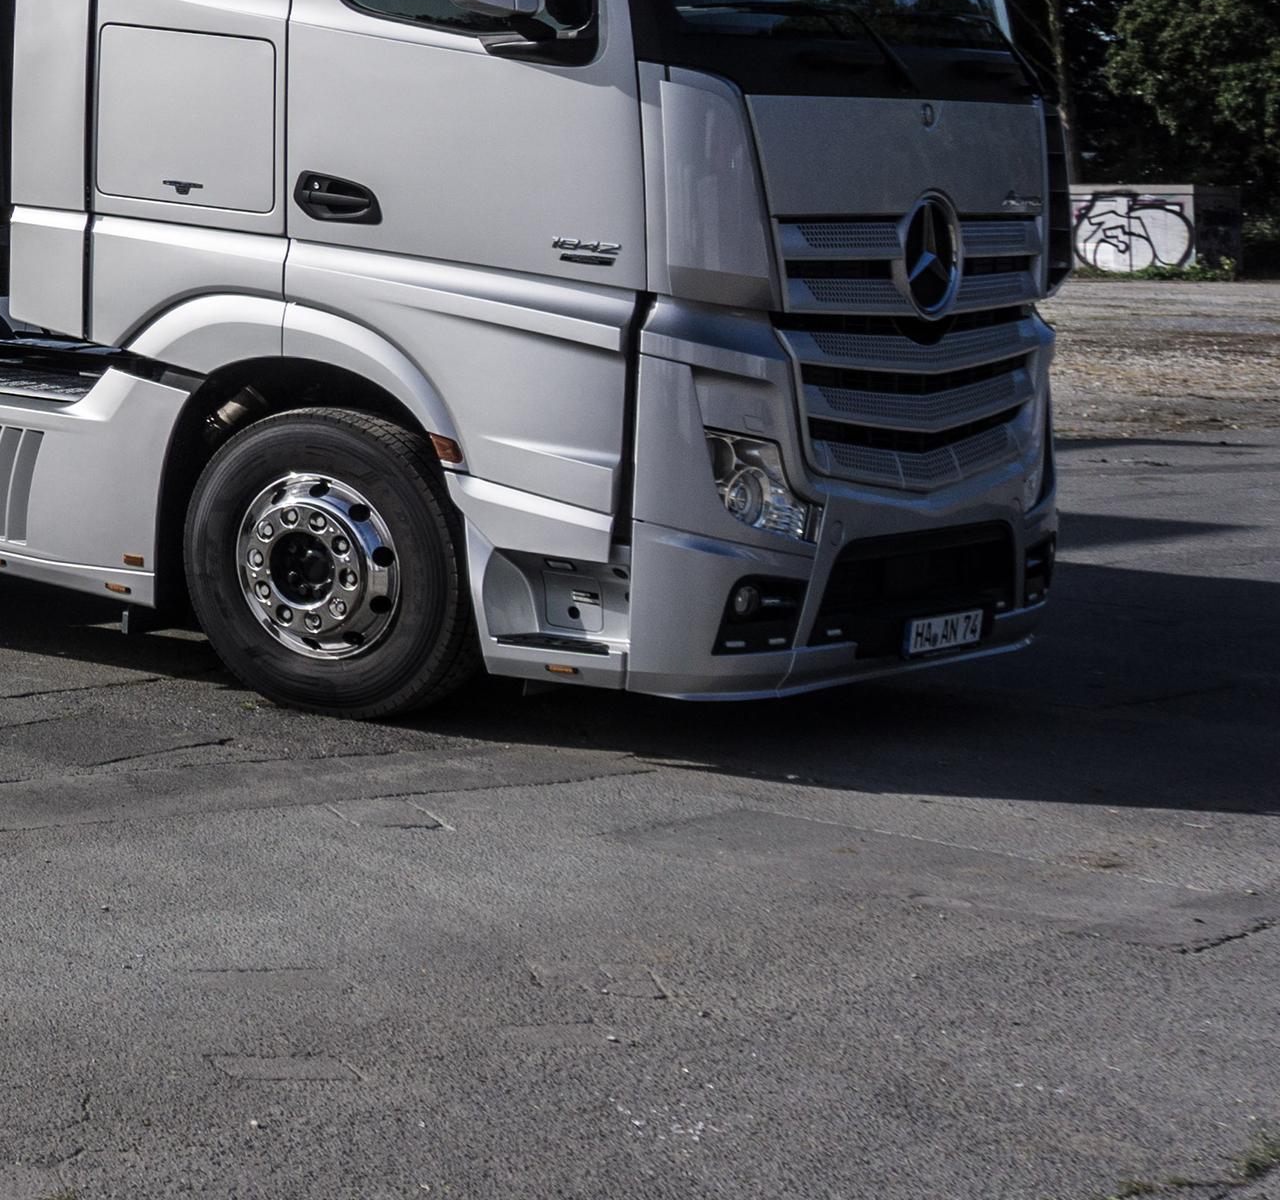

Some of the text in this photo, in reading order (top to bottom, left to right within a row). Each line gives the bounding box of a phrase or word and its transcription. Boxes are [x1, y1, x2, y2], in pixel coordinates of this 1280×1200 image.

[552, 236, 622, 255] 1842
[914, 614, 979, 649] HA AN 74
